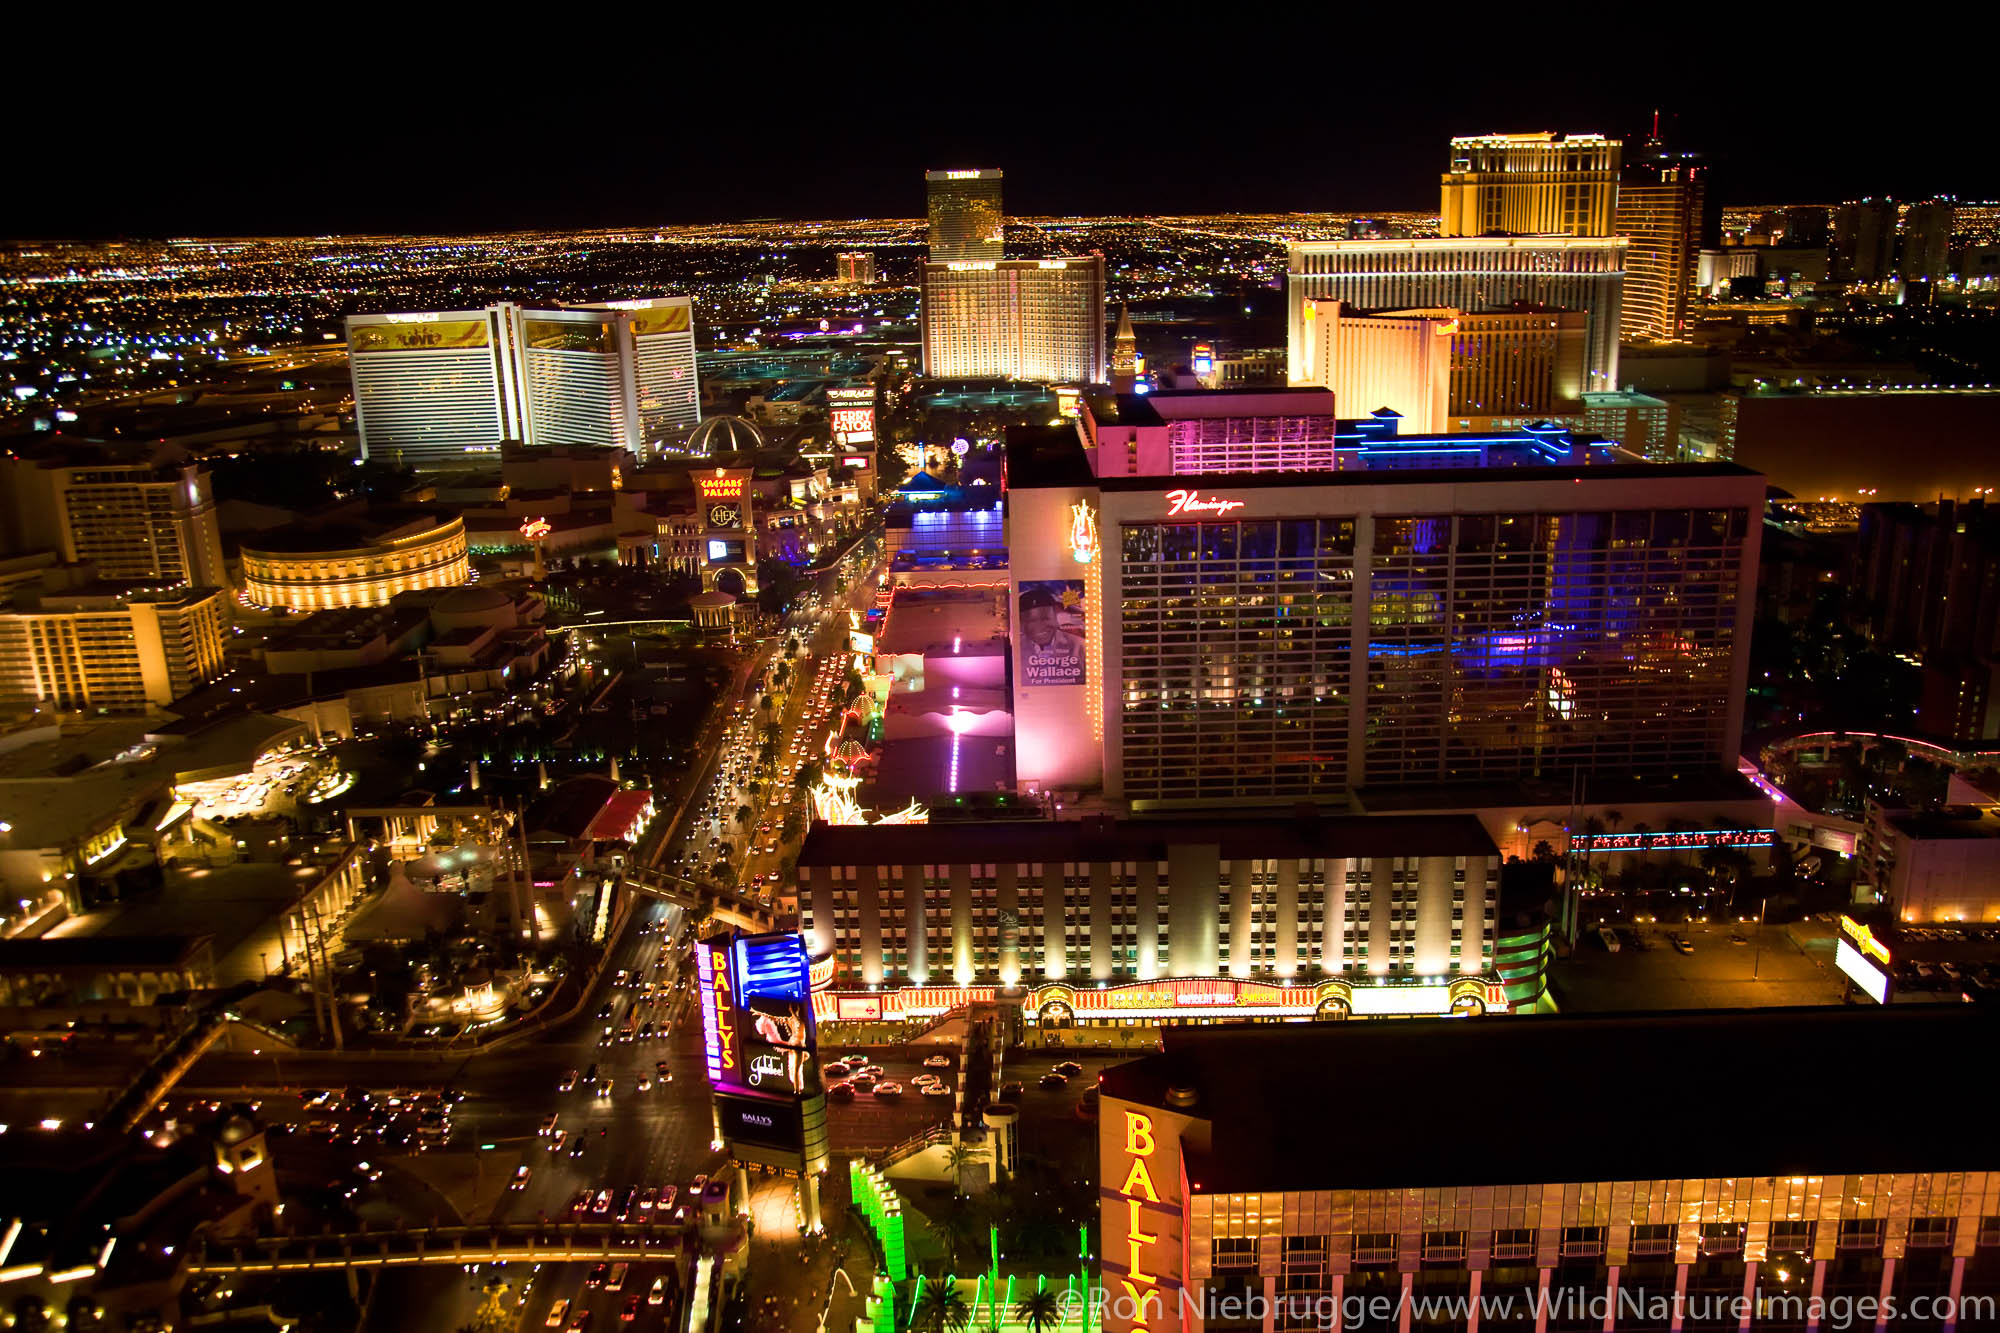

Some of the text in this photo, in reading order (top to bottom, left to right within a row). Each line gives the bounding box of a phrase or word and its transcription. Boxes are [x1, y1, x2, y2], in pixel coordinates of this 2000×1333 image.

[946, 170, 981, 179] TRUMP
[832, 410, 872, 421] TERRY
[833, 420, 872, 431] FATOR
[700, 480, 743, 488] CAESARS
[703, 488, 742, 497] PALACE
[1165, 490, 1245, 517] Flamingo
[1028, 655, 1078, 667] George
[1026, 667, 1081, 678] Wallace
[1119, 1111, 1161, 1333] BALLY
